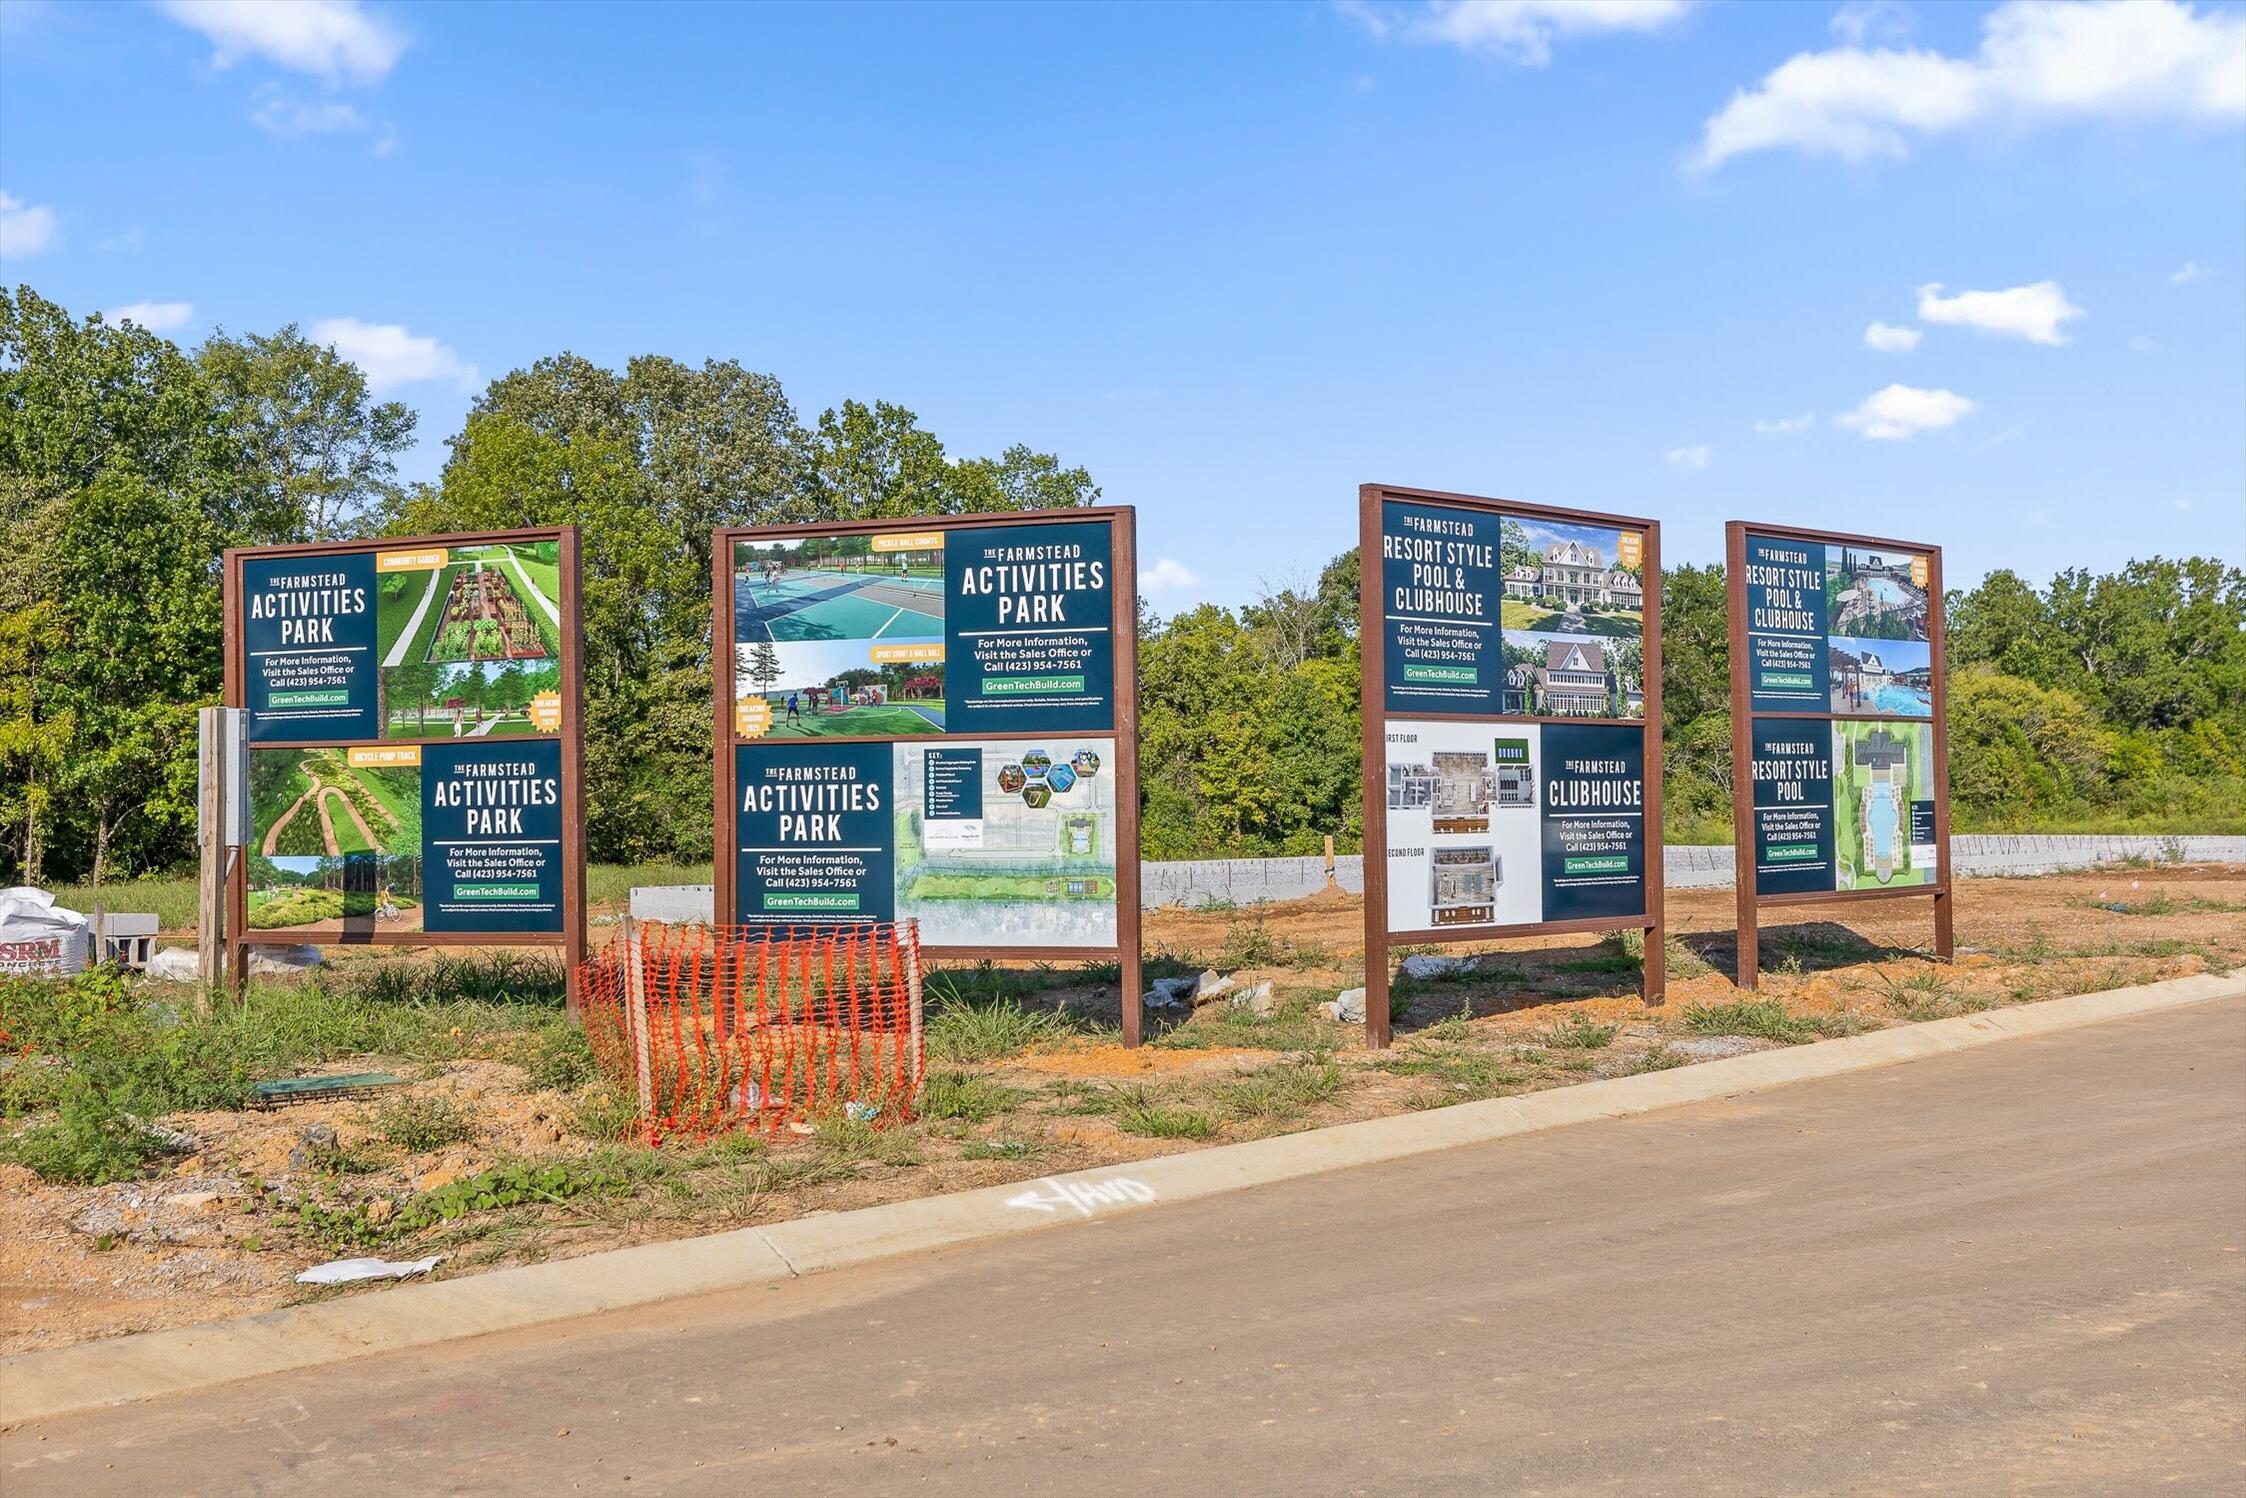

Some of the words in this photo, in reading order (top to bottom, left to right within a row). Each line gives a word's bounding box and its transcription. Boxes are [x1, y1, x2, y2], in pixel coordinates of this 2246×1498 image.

[1404, 516, 1413, 526] THE
[1414, 518, 1474, 536] FARMSTEAD
[984, 549, 996, 558] THE
[998, 544, 1080, 562] FARMSTEAD
[1384, 536, 1442, 563] RESORT
[1447, 542, 1492, 568] STYLE
[1766, 549, 1808, 564] FARMSTEAD
[280, 573, 346, 590] FARMSTEAD
[962, 561, 1104, 595] ACTIVITIES
[1414, 564, 1451, 588] POOL
[1456, 568, 1465, 590] &
[1746, 564, 1786, 587] RESORT
[1788, 569, 1820, 590] STYLE
[251, 588, 365, 619] ACTIVITIES
[1396, 587, 1482, 616] CLUBHOUSE
[1766, 588, 1792, 608] POOL
[1794, 590, 1802, 609] &
[999, 594, 1066, 624] PARK
[1755, 608, 1814, 630] CLUBHOUSE
[282, 618, 334, 644] PARK
[1400, 624, 1412, 634] For
[1414, 625, 1433, 635] More
[1434, 627, 1480, 639] Information,
[978, 639, 994, 648] For
[996, 638, 1022, 648] More
[1024, 636, 1088, 646] Information,
[1398, 636, 1414, 646] Visit
[1416, 638, 1430, 646] the
[1430, 638, 1450, 648] Sales
[1452, 640, 1472, 649] Office
[1474, 642, 1482, 650] or
[265, 658, 278, 667] For
[280, 657, 300, 666] More
[301, 655, 352, 664] Information,
[974, 650, 998, 660] Visit
[1000, 650, 1016, 659] the
[1019, 650, 1046, 658] Sales
[1048, 648, 1078, 658] Office
[1405, 648, 1420, 658] Call
[1421, 649, 1440, 660] (423)
[1442, 651, 1476, 660] 954-7561
[262, 668, 281, 677] Visit
[282, 668, 296, 676] the
[297, 666, 318, 675] Sales
[320, 666, 344, 674] Office
[345, 666, 354, 674] or
[984, 662, 1003, 672] Call
[1006, 661, 1031, 672] (423)
[1034, 660, 1082, 670] 954-7561
[270, 678, 285, 687] Call
[286, 678, 307, 687] (423)
[308, 676, 346, 686] 954-7561
[1407, 669, 1476, 680] GreenTechBuild.com
[986, 680, 1080, 690] GreenTechBuild.com
[272, 694, 346, 704] GreenTechBuild.com
[1386, 734, 1398, 742] IRST
[1400, 734, 1418, 742] FLOOR
[1772, 743, 1814, 754] FARMSTEAD
[454, 764, 464, 774] THE
[466, 763, 535, 777] FARMSTEAD
[766, 768, 777, 777] THE
[779, 766, 856, 780] FARMSTEAD
[1574, 760, 1626, 774] FARMSTEAD
[1752, 760, 1792, 780] RESORT
[1796, 760, 1828, 780] STYLE
[434, 778, 556, 806] ACTIVITIES
[744, 784, 880, 812] ACTIVITIES
[1550, 780, 1641, 806] CLUBHOUSE
[1778, 782, 1804, 800] POOL
[467, 808, 522, 834] PARK
[780, 814, 842, 841] PARK
[1591, 820, 1630, 829] Information,
[1560, 832, 1574, 840] Visit
[1576, 832, 1587, 840] the
[1588, 832, 1605, 840] Sales
[1606, 831, 1624, 839] Office
[450, 848, 464, 856] For
[465, 848, 487, 856] More
[488, 847, 542, 857] Information,
[1388, 848, 1406, 858] ECOND
[1408, 848, 1424, 857] FLOOR
[1566, 843, 1578, 851] Call
[1580, 842, 1596, 852] (423)
[1597, 842, 1626, 850] 954-7561
[447, 859, 468, 867] Visit
[468, 859, 482, 867] the
[484, 858, 507, 867] Sales
[508, 858, 534, 866] Office
[760, 856, 775, 864] For
[778, 856, 800, 864] More
[803, 855, 862, 866] Information,
[1568, 861, 1626, 870] GreenTechBuild.com
[455, 870, 472, 878] Call
[472, 870, 494, 878] (423)
[496, 869, 537, 878] 954-7561
[756, 867, 778, 876] Visit
[780, 867, 796, 876] the
[798, 867, 824, 876] Sales
[826, 867, 854, 876] Office
[856, 868, 866, 876] or
[766, 878, 784, 888] Call
[786, 878, 810, 888] (423)
[812, 878, 857, 887] 954-7561
[456, 888, 536, 896] GreenTechBuild.com
[768, 898, 856, 906] GreenTechBuild.com
[0, 939, 60, 961] SRM
